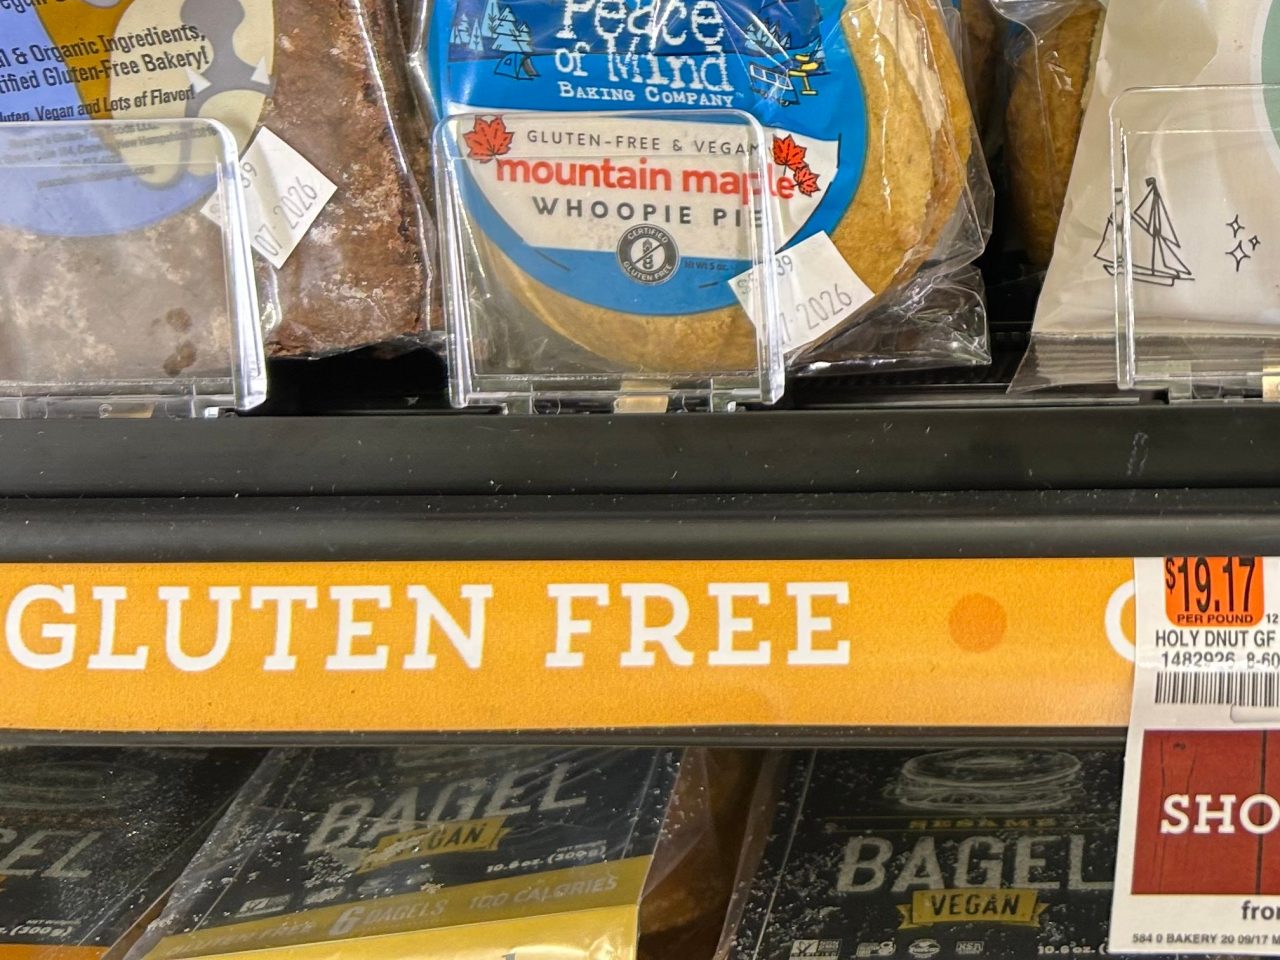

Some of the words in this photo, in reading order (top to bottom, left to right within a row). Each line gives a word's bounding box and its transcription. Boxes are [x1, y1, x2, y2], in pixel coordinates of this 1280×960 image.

[12, 46, 28, 65] &
[29, 37, 100, 63] Organic
[98, 24, 206, 53] Ingredients,
[43, 58, 140, 87] Gluten-Free
[141, 45, 211, 73] Bakery!
[555, 40, 591, 77] of
[604, 37, 735, 92] Mind
[35, 102, 75, 120] Vegan
[78, 98, 101, 116] and
[103, 95, 131, 111] Lots
[135, 92, 148, 109] of
[150, 84, 196, 105] Flavor!
[527, 130, 661, 151] GLUTEN-FREE
[672, 139, 684, 152] &
[496, 155, 672, 191] mountain
[532, 196, 692, 225] WHOOPIE
[712, 207, 763, 229] PIE
[627, 224, 669, 244] CERTIFIED
[624, 261, 653, 281] GLUTEN
[654, 264, 674, 280] FREE
[1165, 556, 1256, 614] $19.17
[4, 582, 495, 672] GLUTEN
[545, 581, 852, 668] FREE
[1177, 614, 1204, 625] PER
[1207, 614, 1254, 625] POUND
[1266, 614, 1279, 625] 12
[1155, 630, 1200, 648] HOLY
[1204, 630, 1250, 648] DNUT
[1253, 630, 1277, 648] GF
[303, 761, 587, 855] BAGEL
[836, 834, 1114, 892] BAGEL
[327, 905, 368, 936] 6
[468, 892, 510, 910] 100
[513, 876, 619, 903] CALORIES
[931, 893, 1021, 918] VEGAN
[1166, 934, 1218, 945] BAKERY
